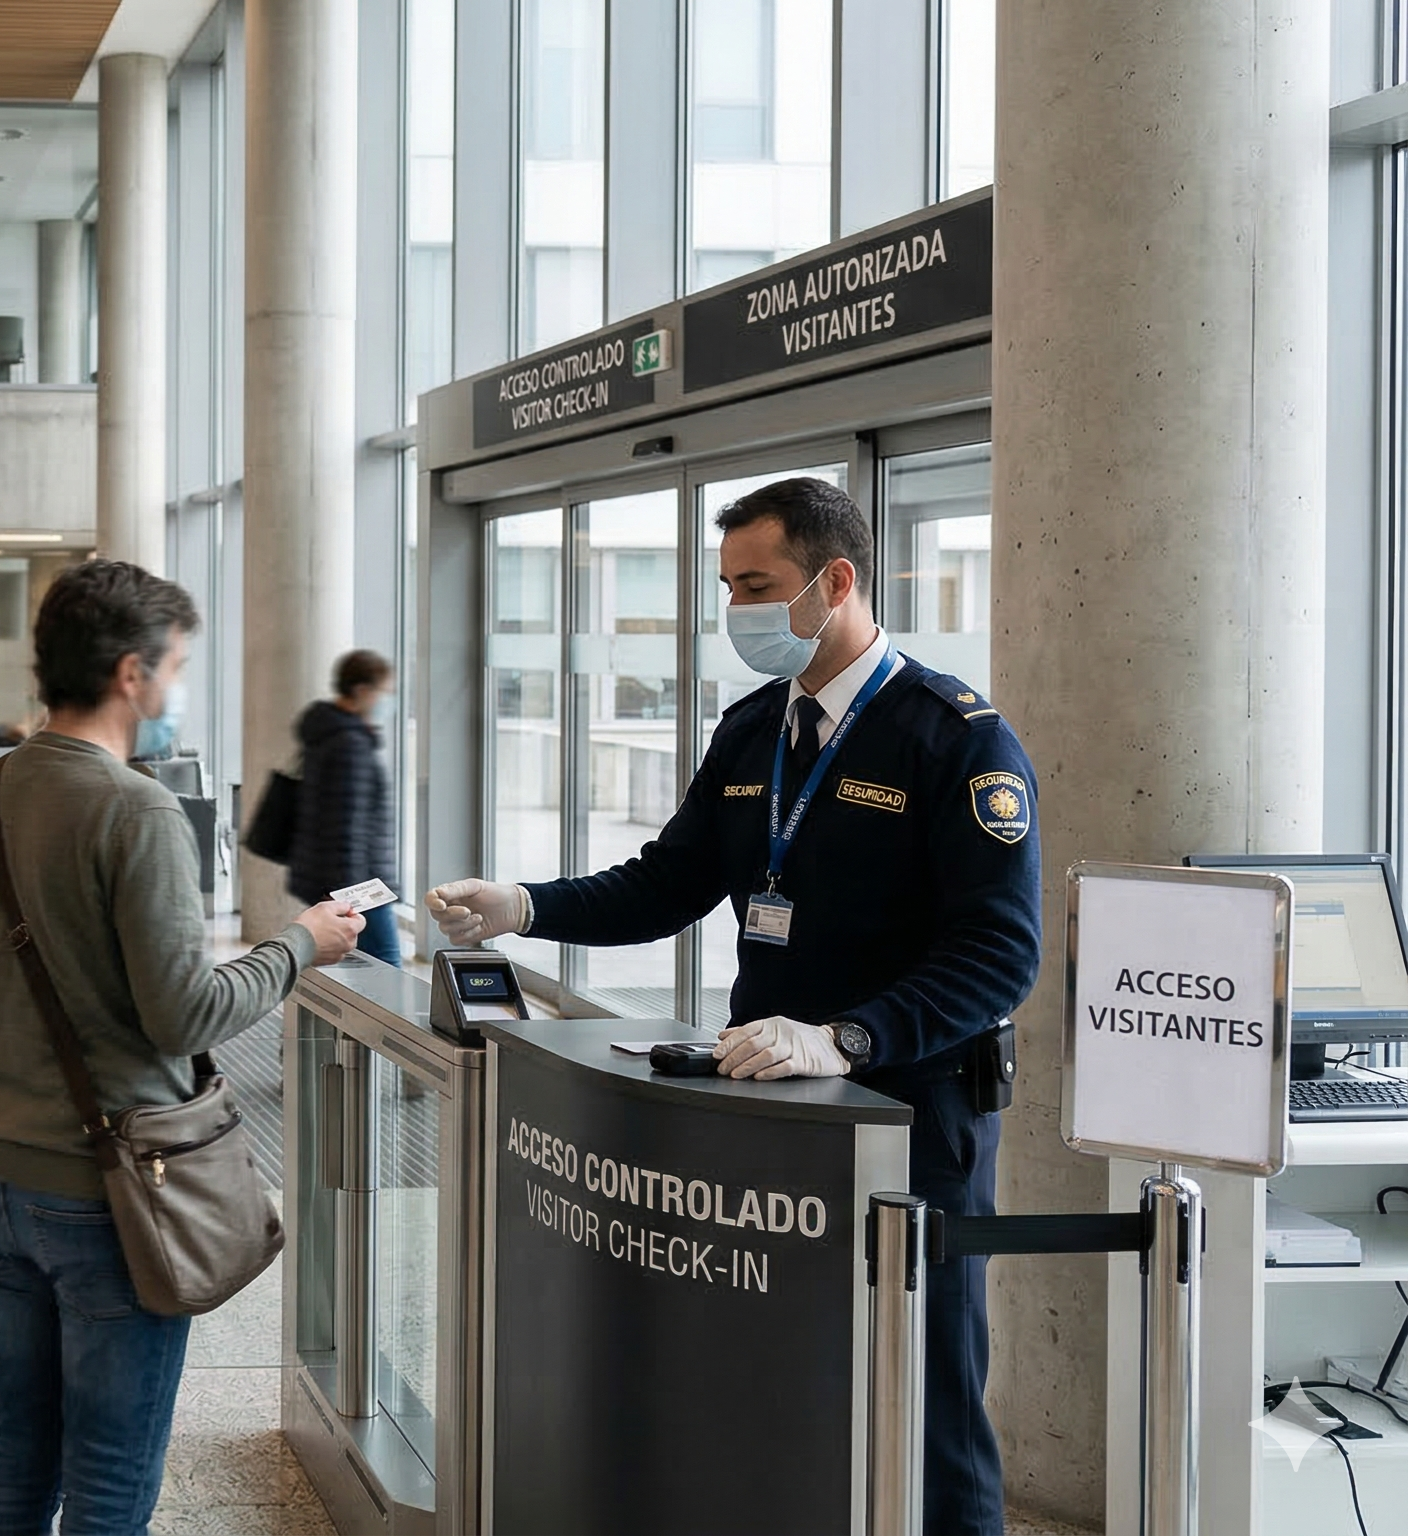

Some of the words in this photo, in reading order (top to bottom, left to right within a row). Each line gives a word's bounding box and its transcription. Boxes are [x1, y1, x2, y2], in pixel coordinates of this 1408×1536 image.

[746, 279, 799, 324] ZONA
[803, 228, 947, 306] AUTORIZADA
[781, 292, 896, 356] VISITANTES
[499, 367, 539, 403] ACCESO
[541, 338, 625, 389] CONTROLADO
[511, 397, 552, 431] VISITOR
[554, 379, 609, 419] CHECK-IN
[1115, 968, 1235, 1003] ACCESO
[1088, 1005, 1264, 1048] VISITANTES
[507, 1116, 578, 1184] ACCESO
[584, 1152, 827, 1239] CONTROLADO
[526, 1179, 600, 1252] VISITOR
[609, 1219, 768, 1293] CHECK-IN
